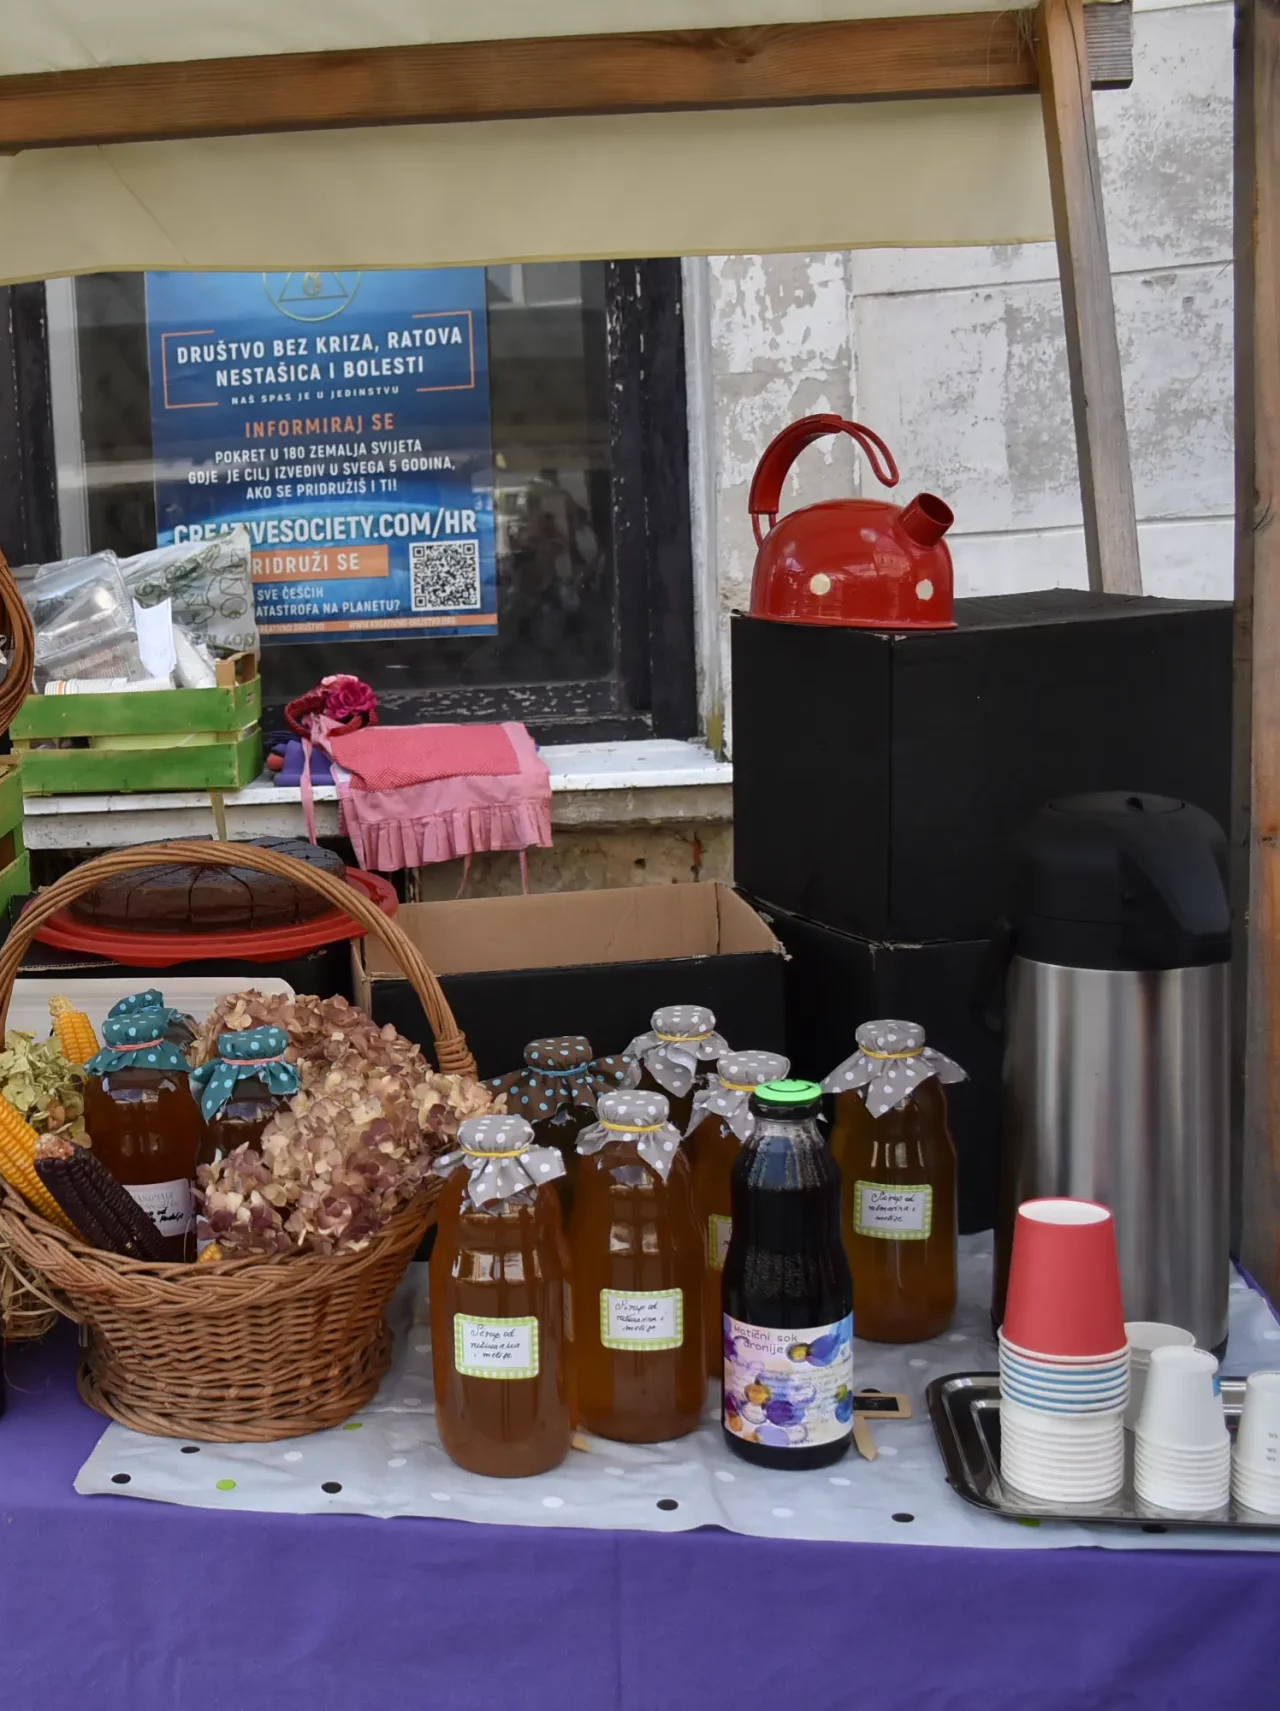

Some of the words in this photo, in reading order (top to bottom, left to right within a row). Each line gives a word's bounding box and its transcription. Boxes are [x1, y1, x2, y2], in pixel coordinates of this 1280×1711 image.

[177, 340, 265, 364] DRUŠTVO
[273, 338, 308, 357] BEZ
[316, 333, 380, 354] KRIZA,
[387, 327, 462, 349] RATOVA
[216, 361, 321, 387] NESTAŠICA
[329, 363, 335, 379] I
[344, 356, 424, 378] BOLESTI
[231, 394, 255, 405] NAŠ
[261, 393, 292, 403] SPAS
[298, 392, 310, 402] JE
[317, 391, 324, 399] U
[331, 386, 399, 400] JEDINSTVU
[245, 415, 363, 438] INFORMIRAJ
[372, 413, 394, 430] SE
[215, 449, 266, 464] POKRET
[270, 449, 279, 460] U
[283, 446, 305, 460] 180
[309, 443, 367, 458] ZEMALJA
[371, 439, 422, 454] SVIJETA
[188, 470, 218, 485] GDJE
[226, 469, 240, 484] JE
[244, 468, 269, 482] CILJ
[275, 464, 325, 479] IZVEDIV
[330, 463, 339, 476] U
[343, 460, 385, 475] SVEGA
[389, 459, 397, 472] 5
[401, 456, 455, 472] GODINA,
[246, 486, 272, 499] AKO
[276, 485, 292, 497] SE
[297, 477, 366, 497] PRIDRUŽIŠ
[371, 479, 375, 492] I
[380, 478, 397, 492] TI!
[253, 551, 329, 575] RIDRUŽI
[337, 554, 360, 571] SE
[257, 588, 278, 601] SVE
[256, 603, 319, 617] ATASTROFA
[323, 603, 338, 614] NA
[342, 600, 400, 613] PLANETU?
[734, 1325, 770, 1341] Matični
[777, 1334, 798, 1343] sok
[743, 1340, 785, 1355] aronije
